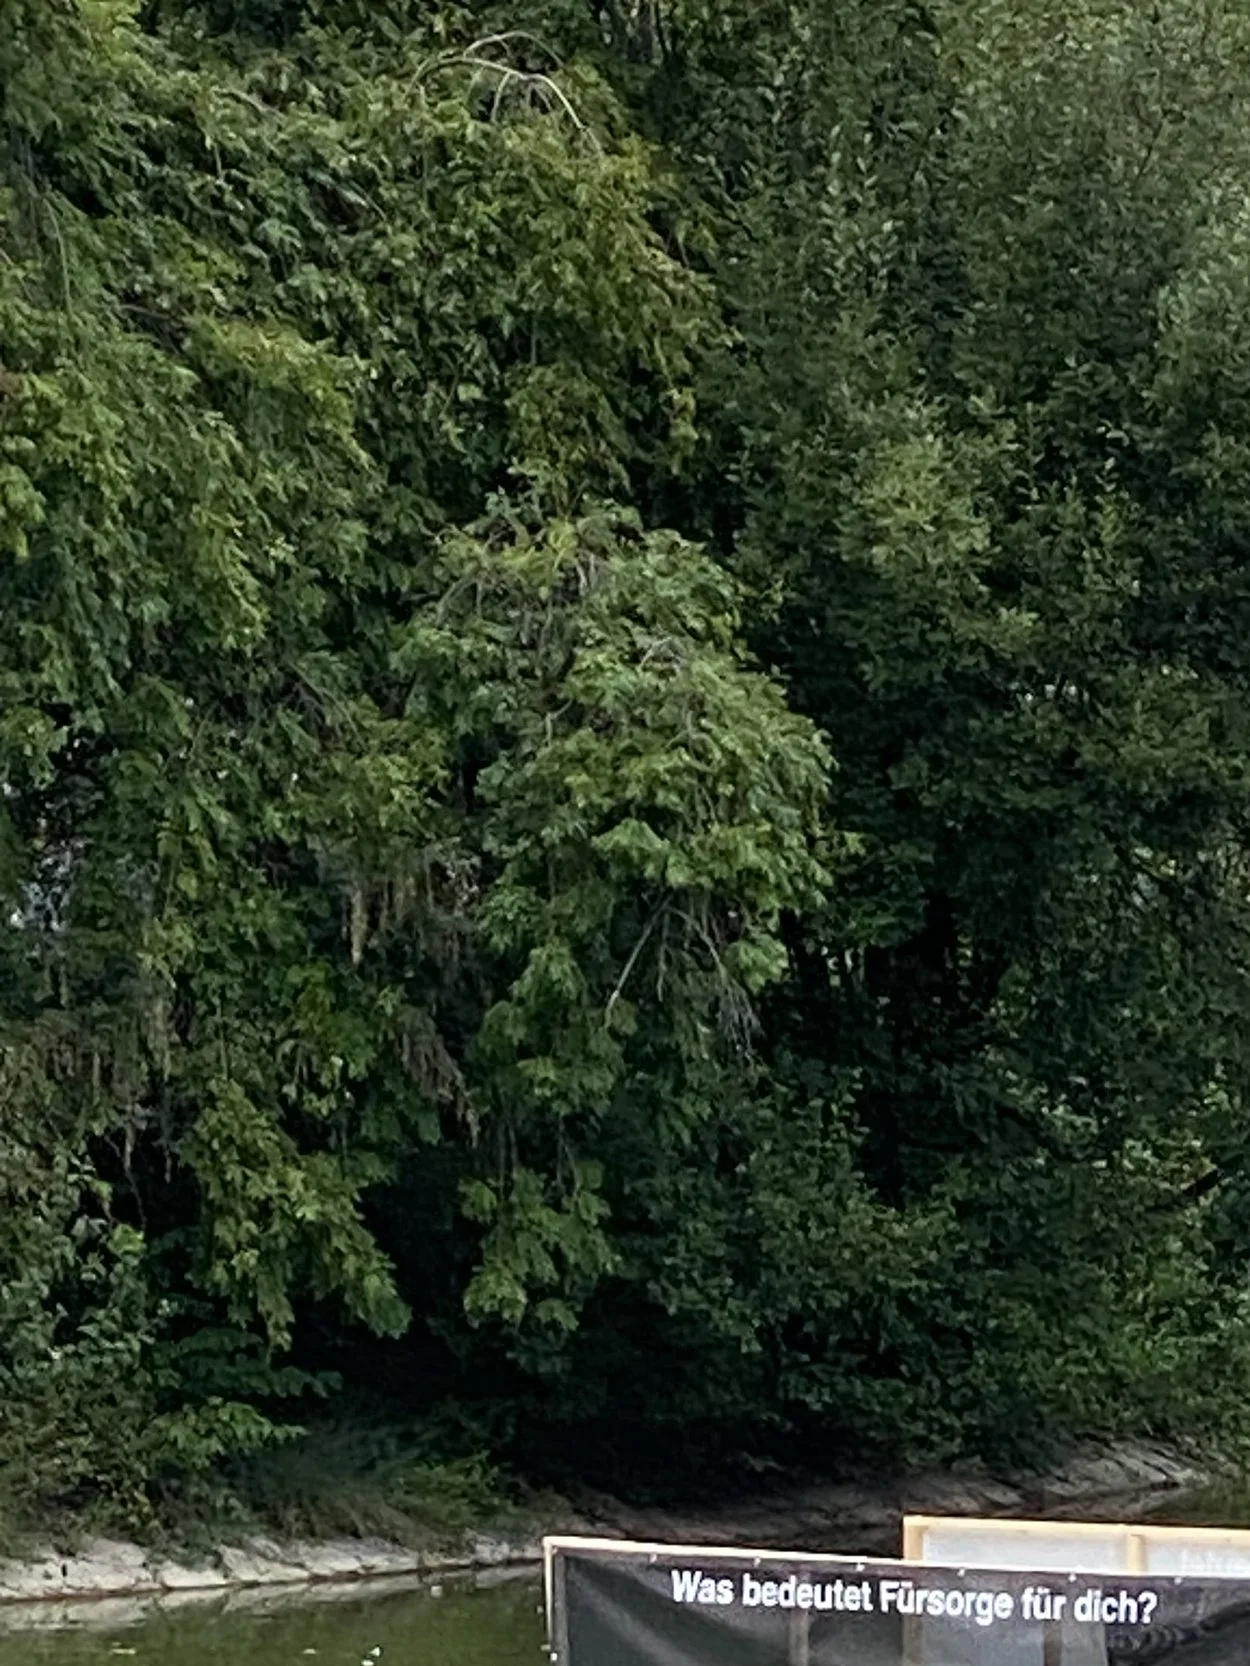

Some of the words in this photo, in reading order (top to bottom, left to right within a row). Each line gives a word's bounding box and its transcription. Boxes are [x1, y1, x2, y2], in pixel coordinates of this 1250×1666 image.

[672, 1570, 734, 1604] Was
[742, 1573, 873, 1610] bedeutet
[880, 1581, 1014, 1620] Fürsorge
[1021, 1587, 1067, 1620] für
[1072, 1589, 1157, 1624] dich?
